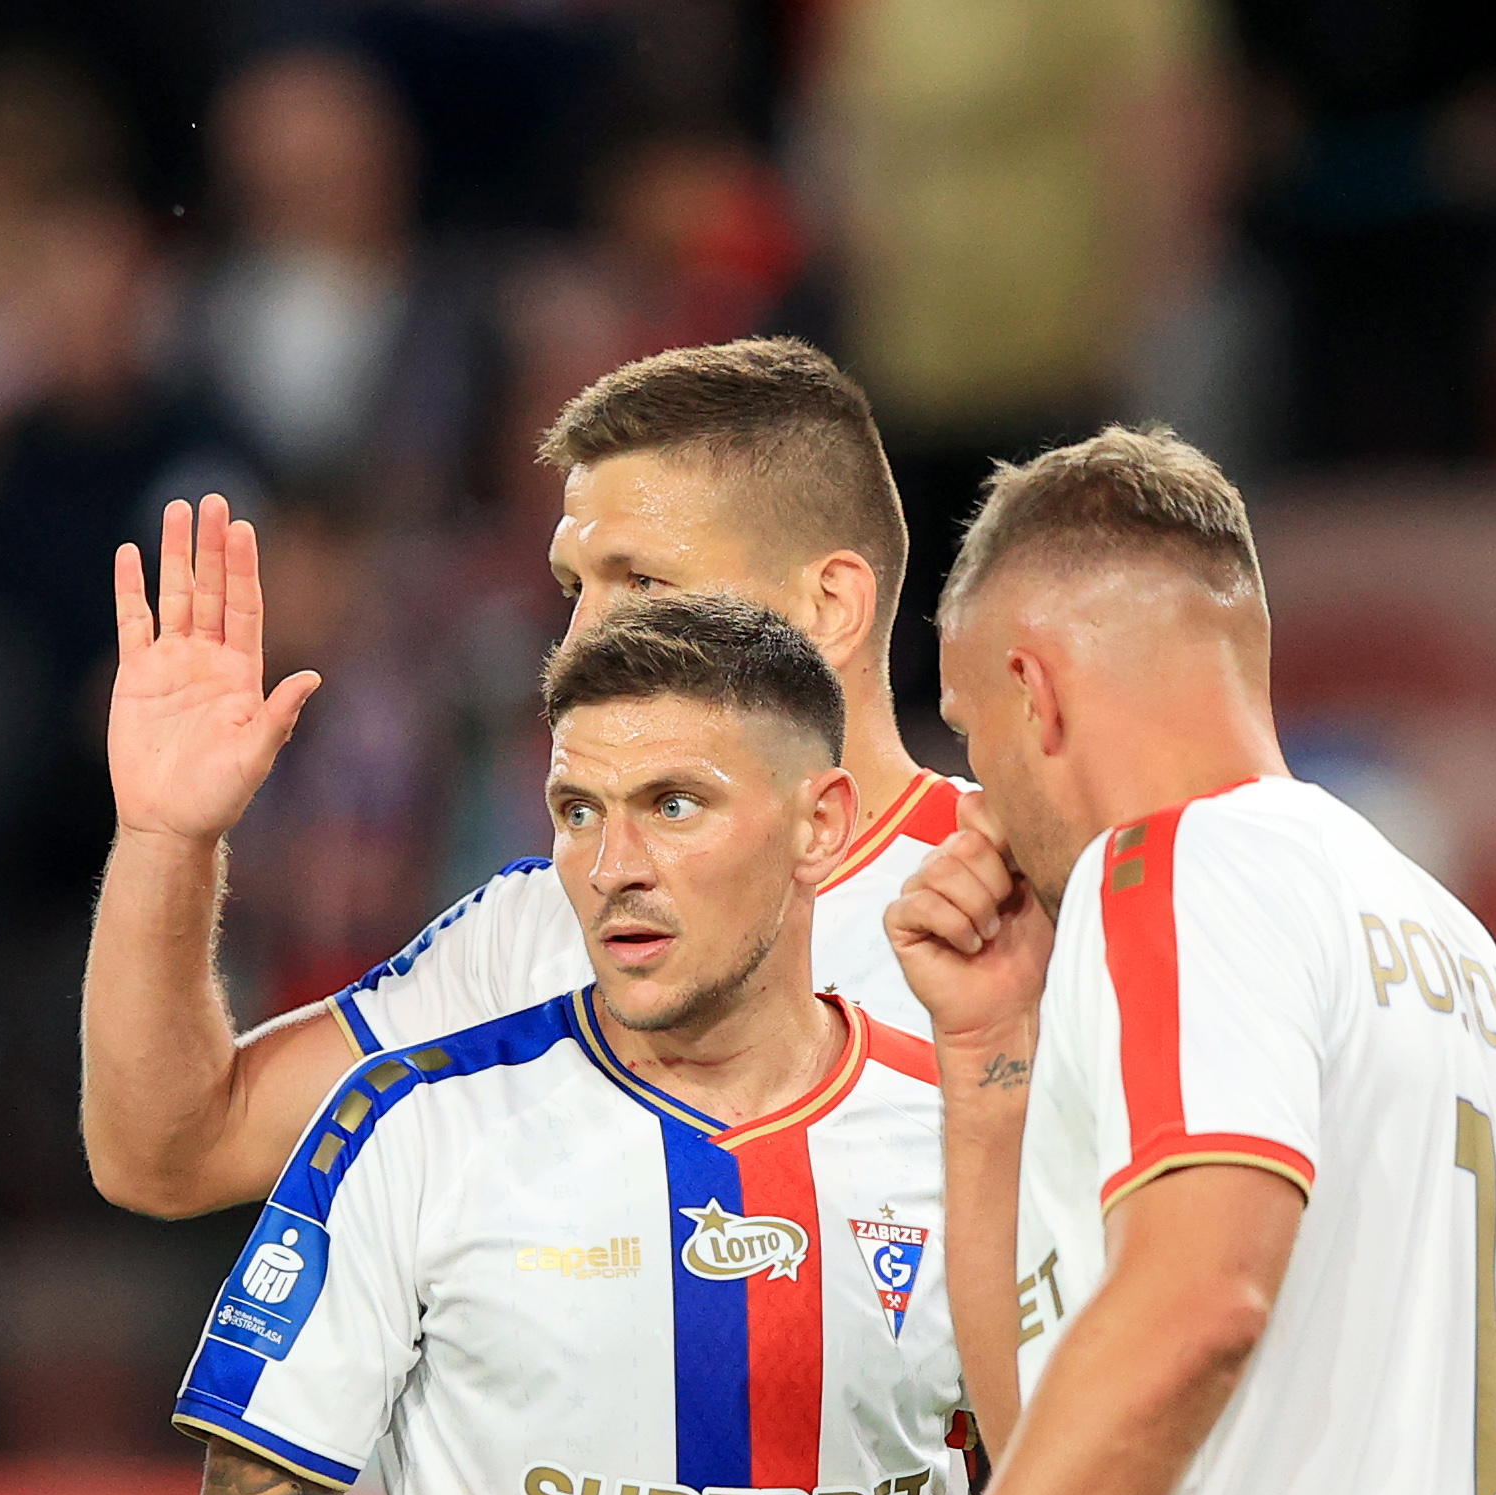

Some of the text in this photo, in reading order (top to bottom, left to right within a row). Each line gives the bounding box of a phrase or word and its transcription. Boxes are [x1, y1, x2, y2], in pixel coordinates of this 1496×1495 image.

[710, 1230, 781, 1264] LOTTO
[855, 1221, 923, 1244] ZABRZE
[515, 1237, 642, 1277] capelli
